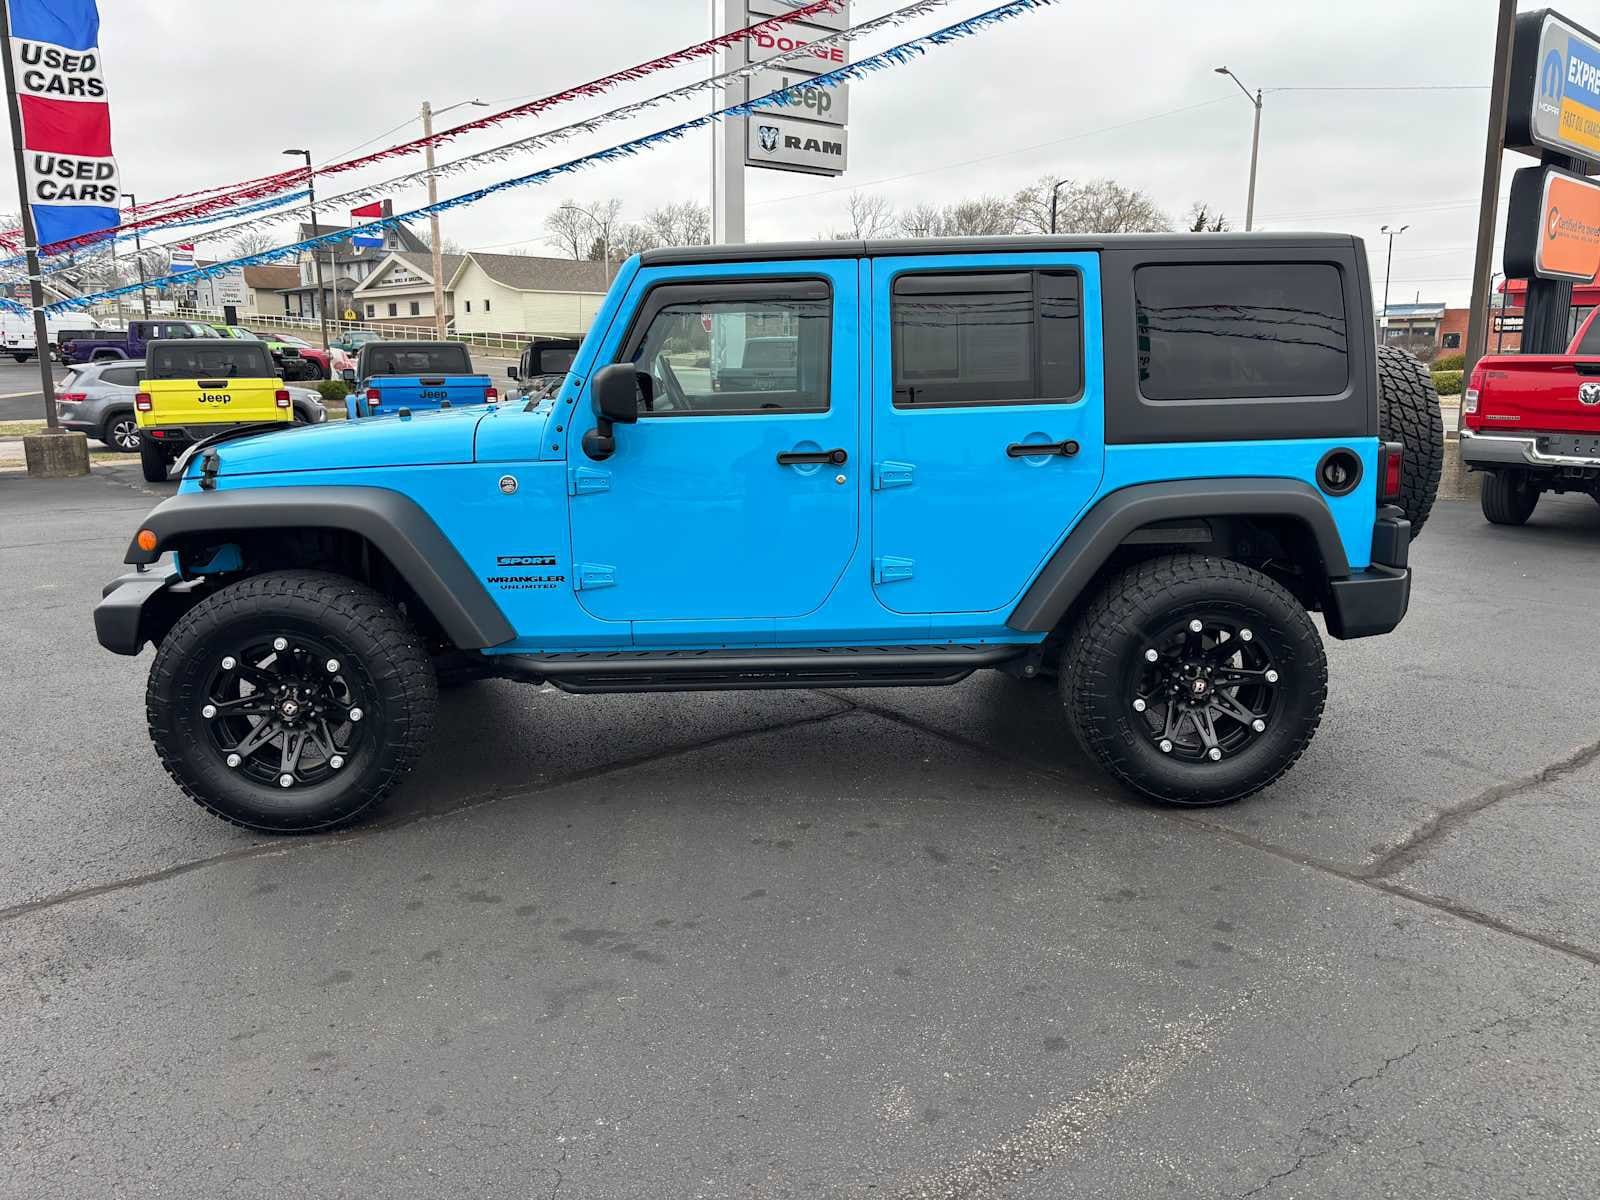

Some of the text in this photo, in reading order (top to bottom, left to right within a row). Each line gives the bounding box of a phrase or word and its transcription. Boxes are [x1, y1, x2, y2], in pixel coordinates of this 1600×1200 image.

[20, 43, 96, 73] USED
[23, 70, 105, 97] CARS
[784, 135, 842, 156] RAM
[33, 154, 115, 181] USED
[36, 180, 118, 203] CARS
[198, 393, 231, 404] Jeep
[419, 389, 448, 400] Jeep
[500, 556, 555, 565] SPORT
